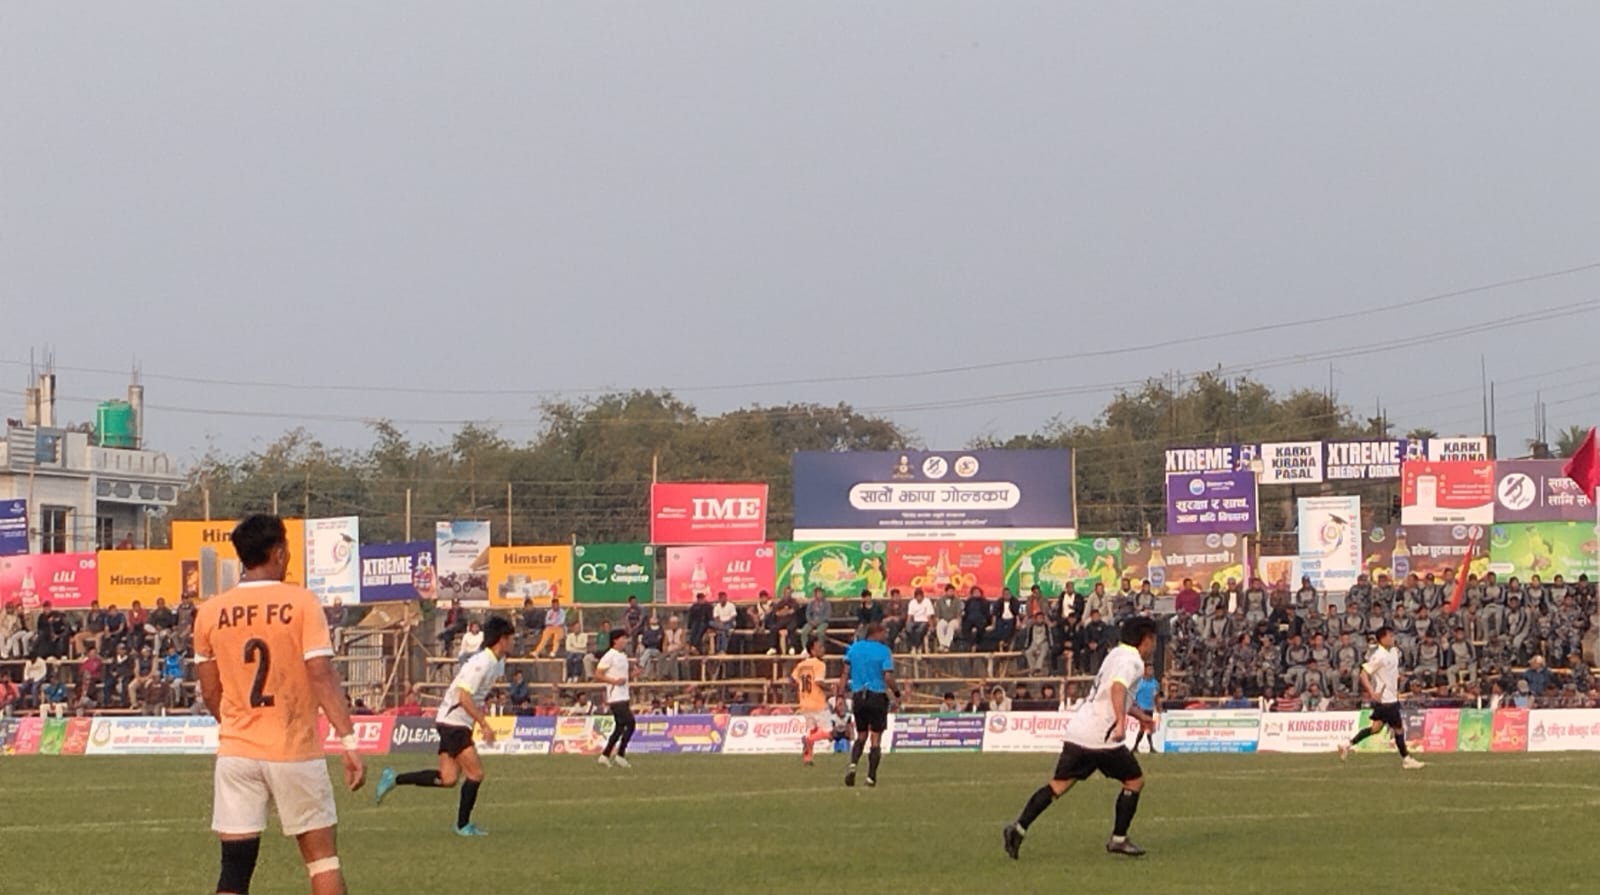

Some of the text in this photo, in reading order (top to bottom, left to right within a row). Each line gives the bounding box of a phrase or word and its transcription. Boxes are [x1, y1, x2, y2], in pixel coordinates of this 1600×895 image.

[1276, 446, 1311, 457] KARKI
[1328, 442, 1400, 464] XTREME
[1444, 442, 1480, 453] KARKI
[1165, 447, 1233, 471] XTREME
[1272, 457, 1317, 468] KIRANA
[1275, 468, 1313, 480] PASAL
[1327, 465, 1366, 479] ENERGY
[898, 489, 936, 503] झापा
[941, 485, 1009, 503] गोल्डकप
[692, 498, 761, 520] IME
[363, 556, 412, 576] XTREME
[503, 553, 558, 565] Himstar
[110, 574, 162, 586] Himstar
[578, 563, 608, 584] QC
[610, 574, 649, 585] Computer
[218, 603, 293, 630] APF FC
[244, 638, 275, 708] 2
[1288, 719, 1356, 732] KINGSBURY
